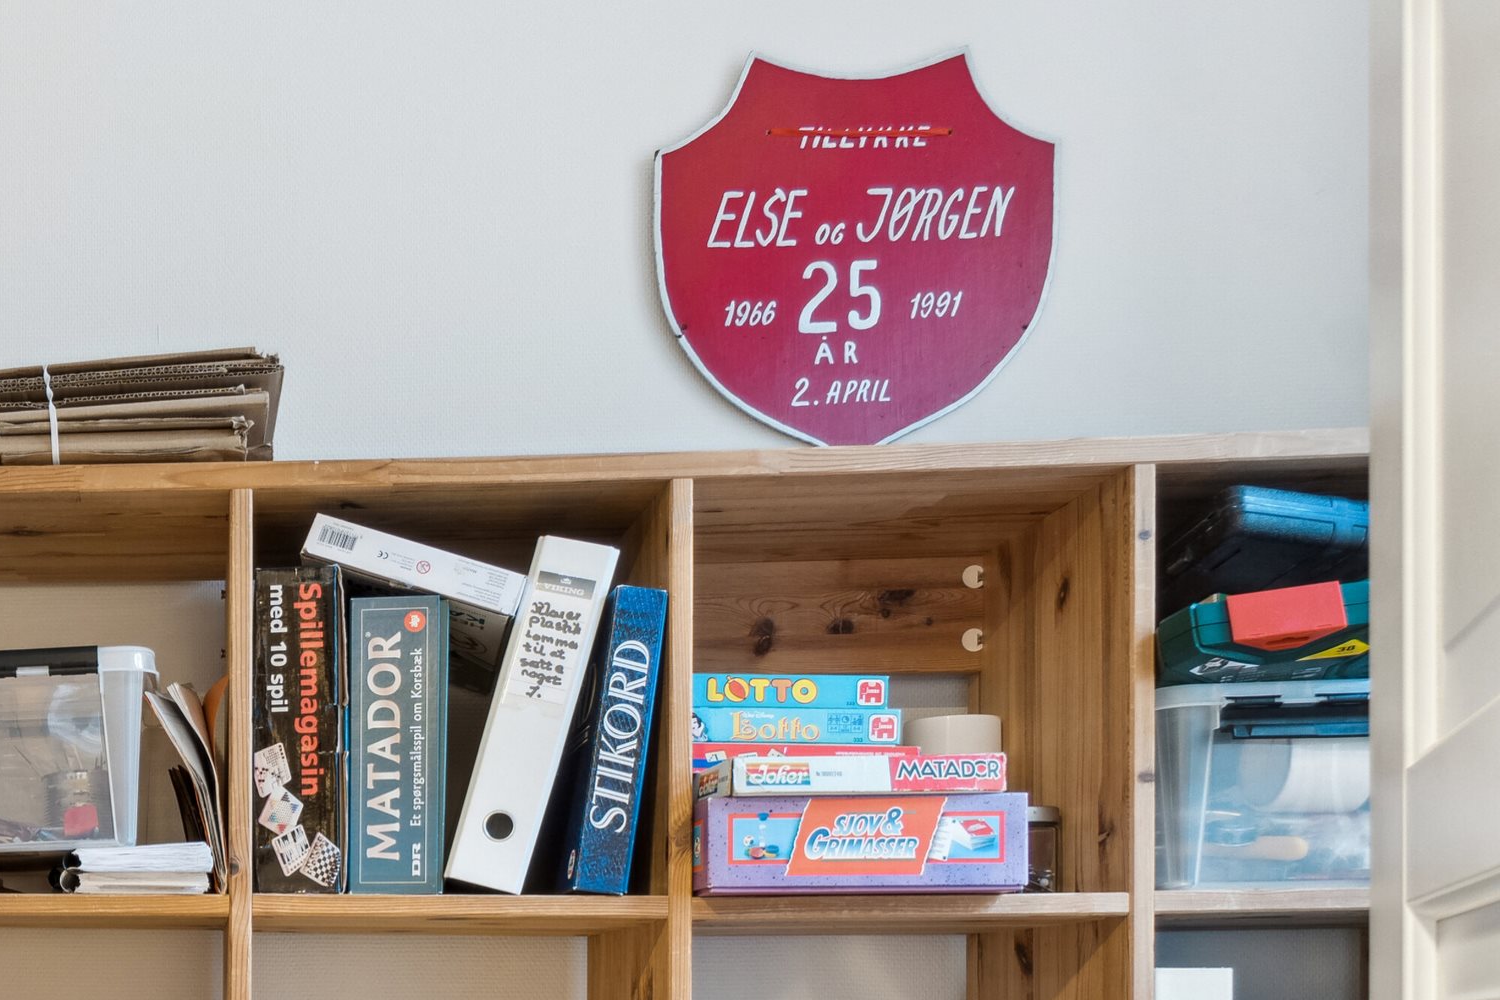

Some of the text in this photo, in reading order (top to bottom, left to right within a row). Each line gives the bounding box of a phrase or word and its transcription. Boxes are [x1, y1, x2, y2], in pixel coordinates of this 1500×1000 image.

[706, 188, 808, 249] ELSE
[855, 186, 1016, 243] JØRGEN
[797, 259, 882, 334] 25
[909, 290, 964, 320] 1991
[723, 299, 777, 328] 1966
[814, 334, 860, 366] ÅR
[790, 378, 891, 408] 2. APRIL
[543, 581, 585, 597] VIKING
[266, 584, 289, 713] med 10 spil
[292, 582, 324, 796] Spillemagasin
[706, 675, 818, 704] LOTTO
[409, 647, 425, 828] Et spørgsmålsspil om Korsbæk
[589, 639, 652, 834] STIKORD
[731, 710, 820, 741] Lotto
[365, 631, 403, 863] MATADOR
[750, 764, 810, 785] Joker
[896, 759, 1002, 781] MATADOR
[832, 813, 884, 837] SJOV
[411, 842, 422, 877] DR
